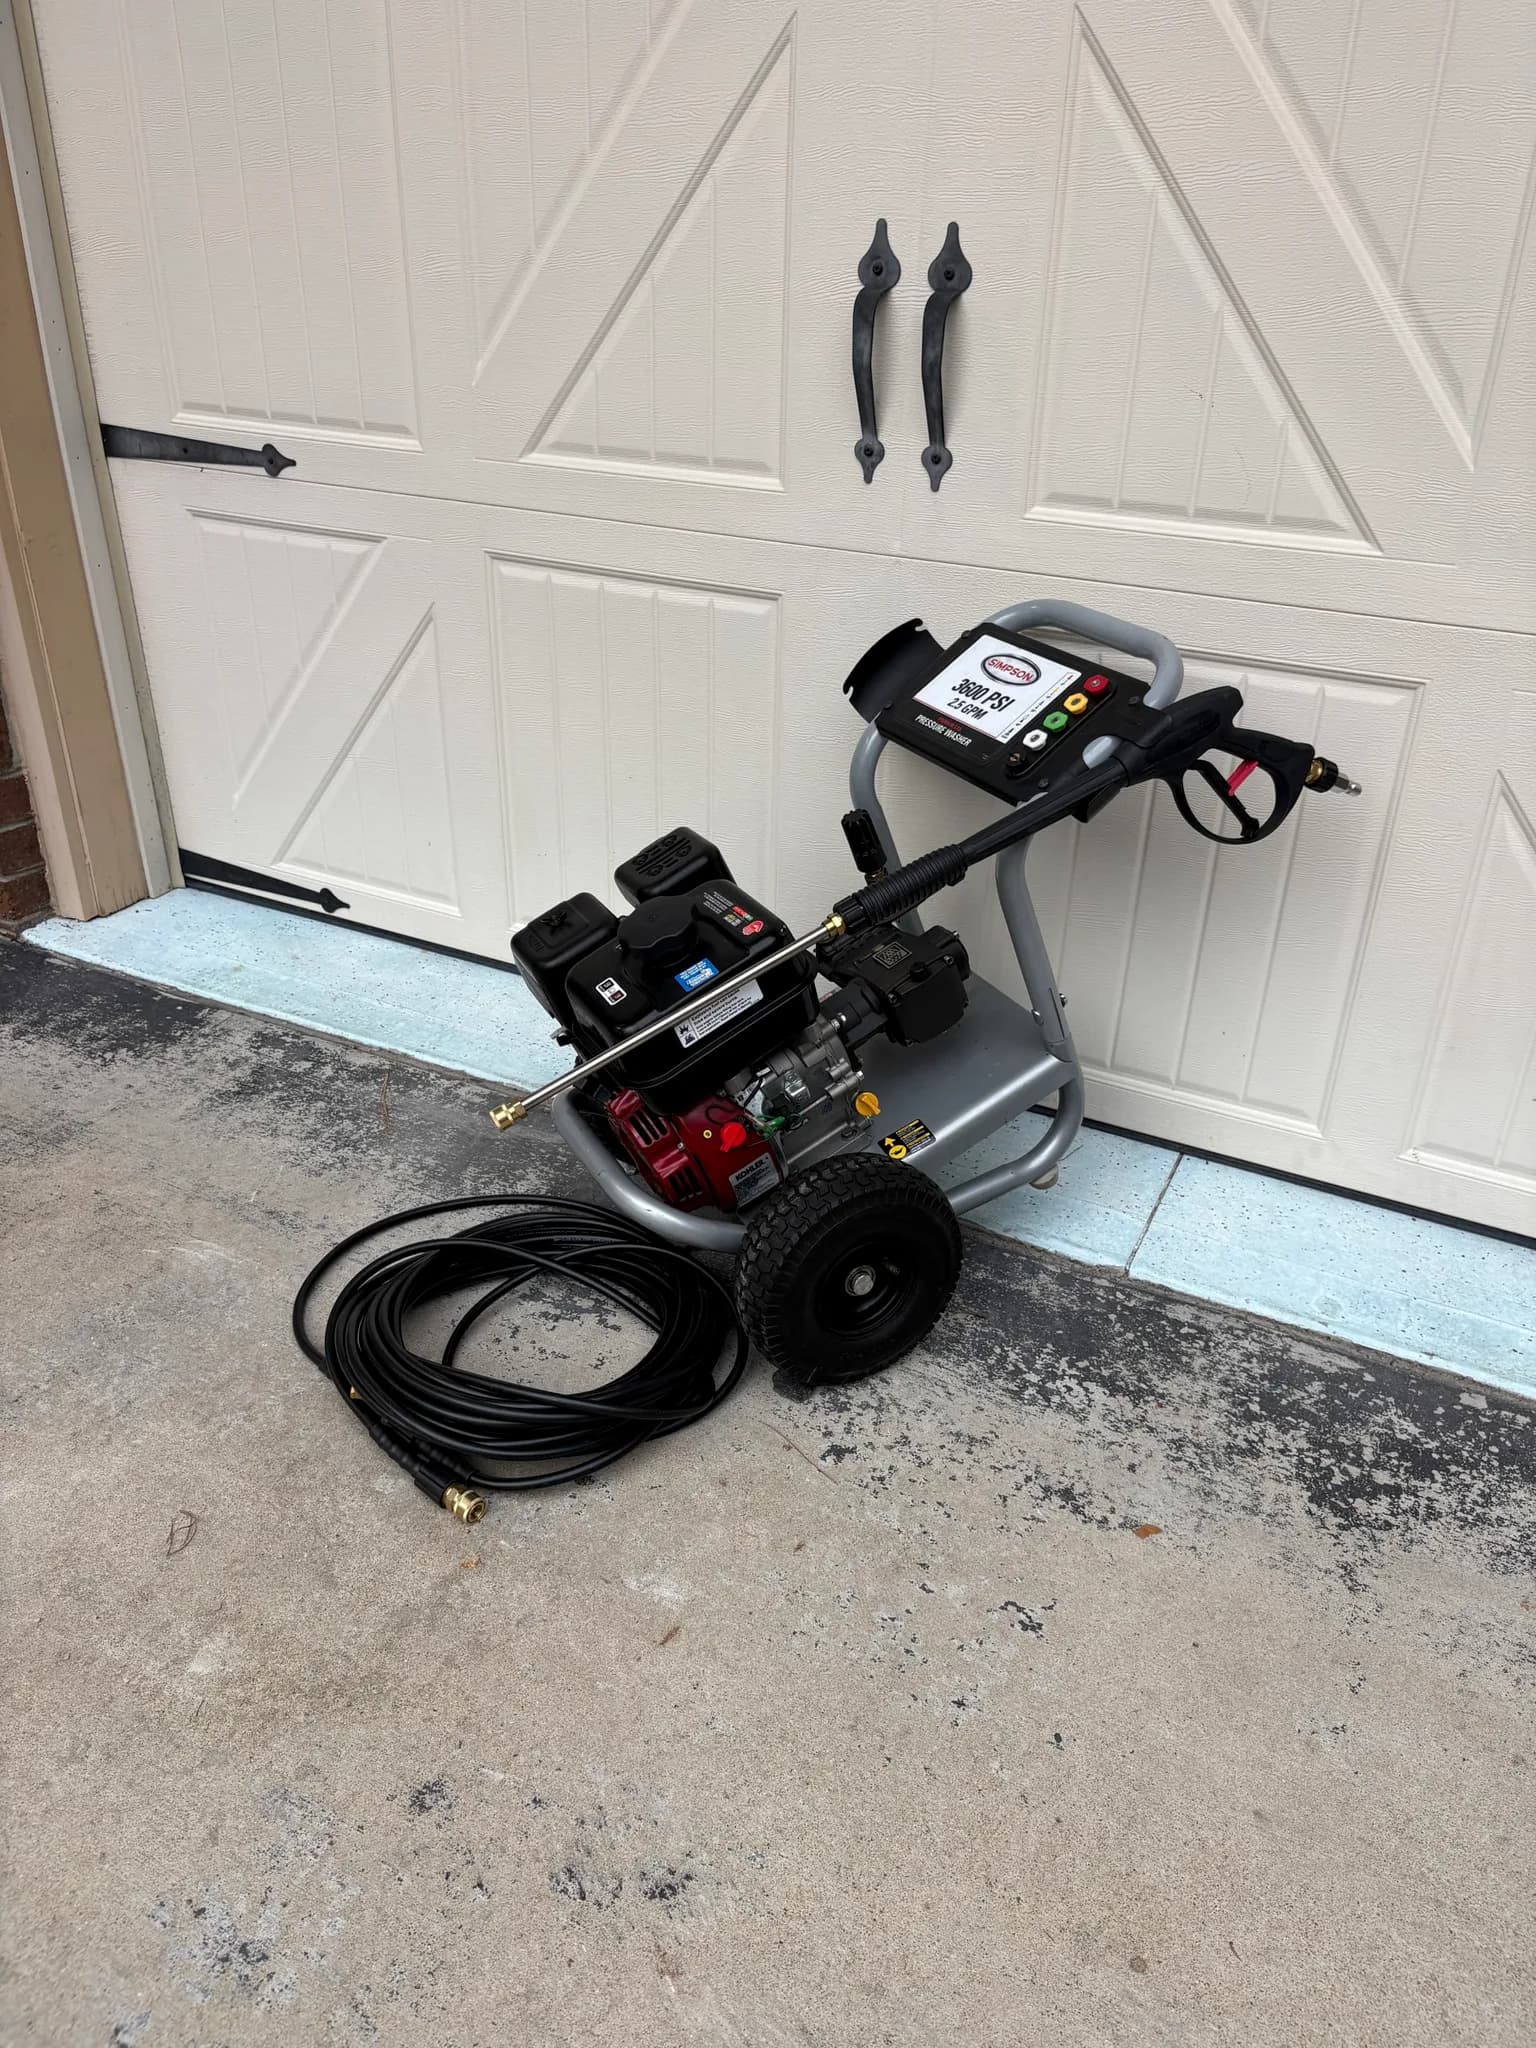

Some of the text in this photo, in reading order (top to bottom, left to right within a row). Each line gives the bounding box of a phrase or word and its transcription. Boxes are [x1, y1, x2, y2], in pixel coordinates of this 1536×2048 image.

[987, 658, 1034, 682] SIMPSON
[951, 678, 990, 700] 3600
[980, 691, 1016, 712] PSI
[960, 703, 988, 720] GPM
[914, 714, 947, 734] PRESSURE
[943, 729, 972, 747] WASHER
[735, 1159, 765, 1181] KOHLER
